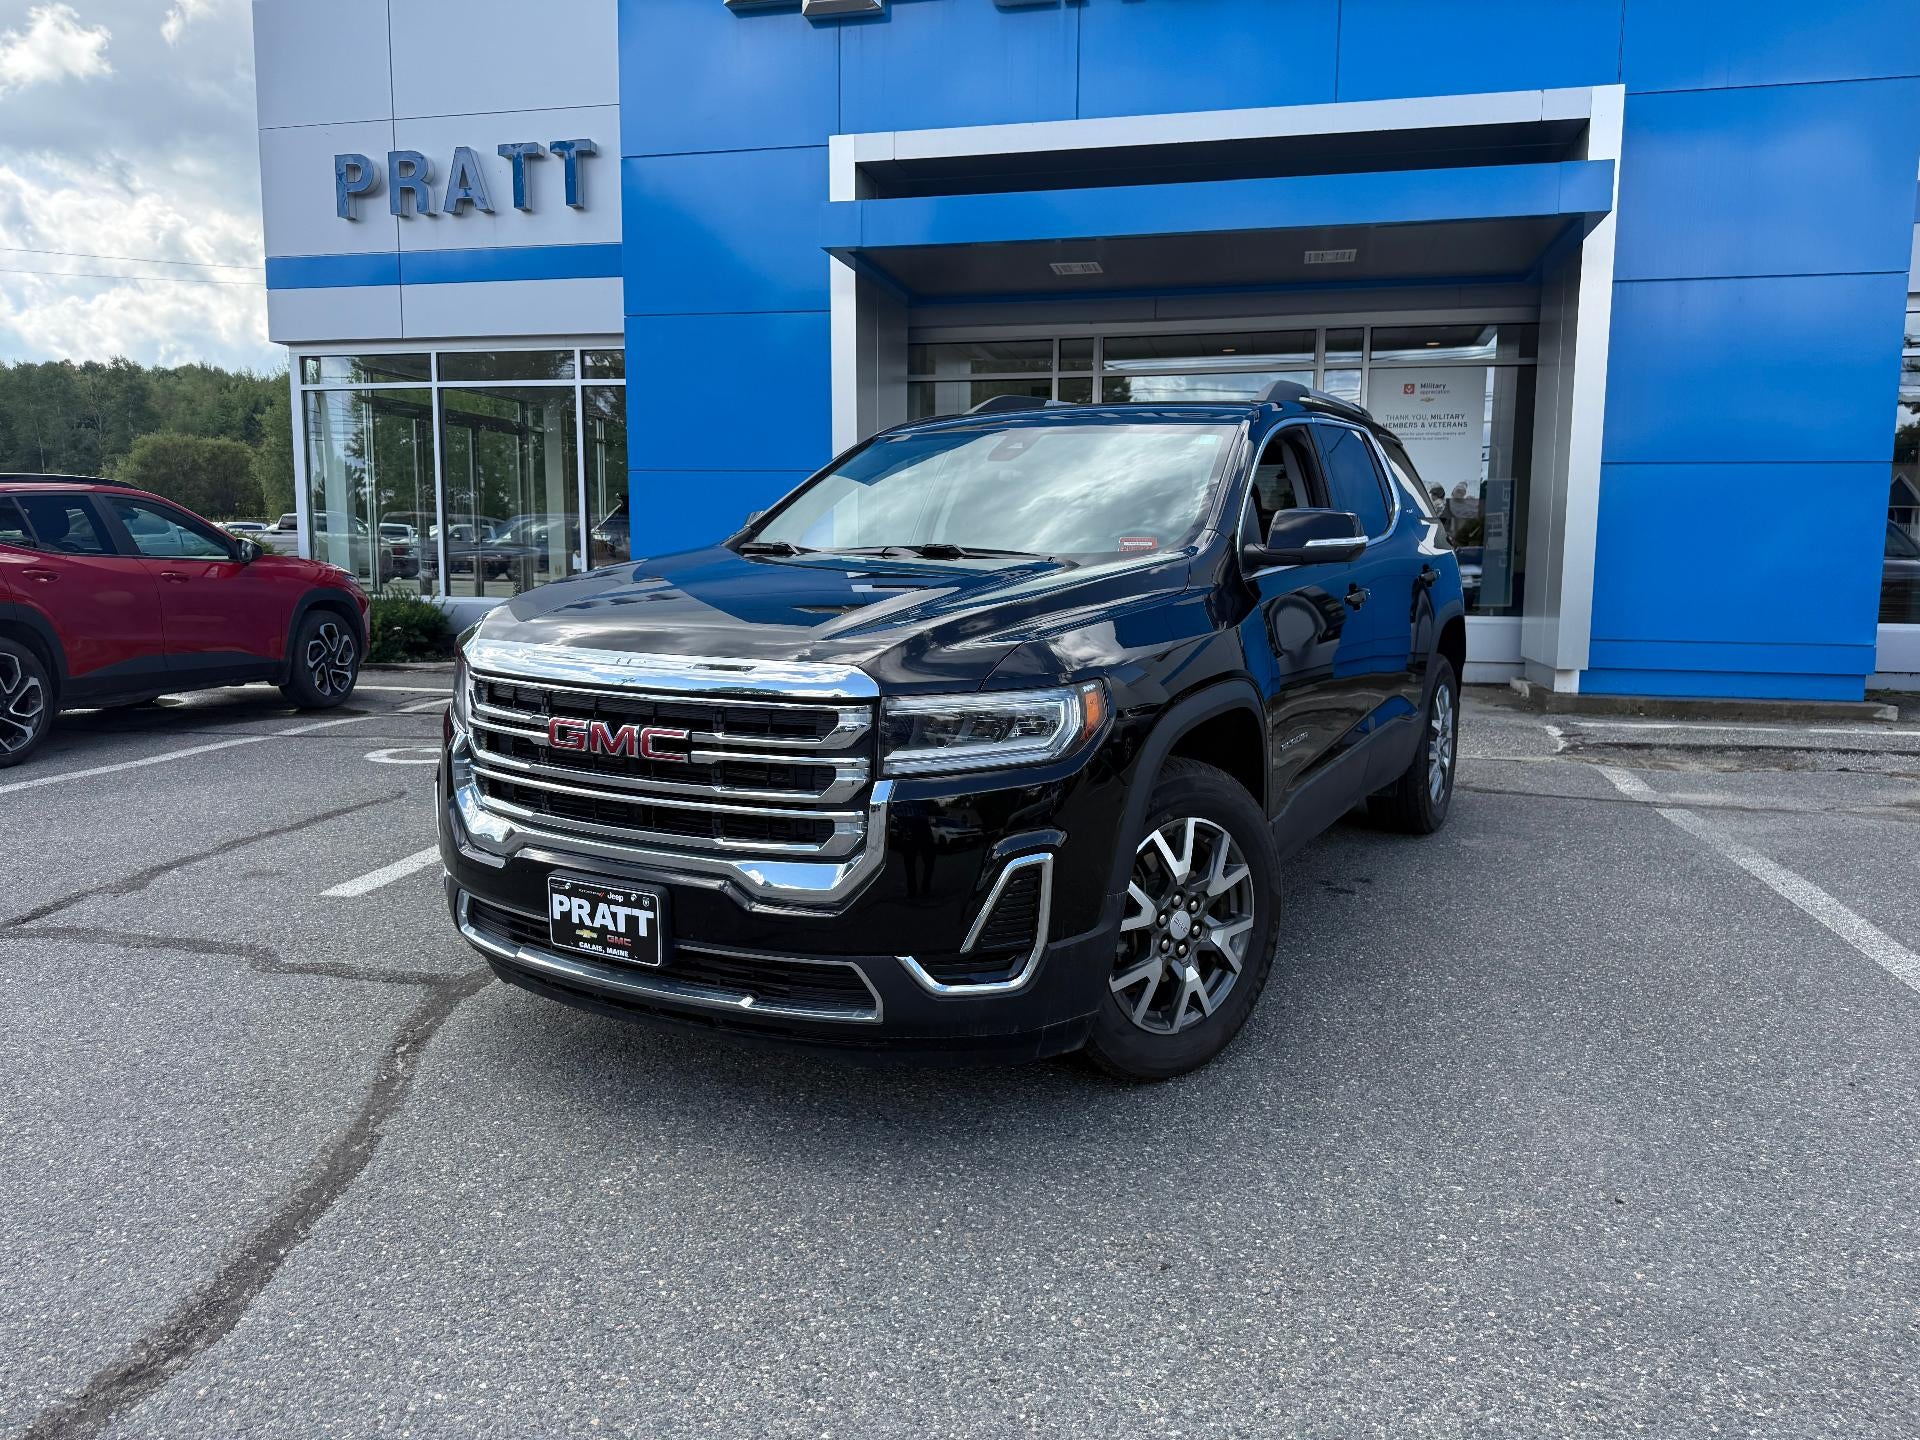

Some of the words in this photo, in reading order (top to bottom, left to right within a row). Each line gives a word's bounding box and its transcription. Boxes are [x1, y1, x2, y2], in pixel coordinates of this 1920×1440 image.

[334, 139, 597, 220] PRATT
[548, 716, 690, 763] GMC
[607, 892, 624, 902] Jeep
[552, 893, 655, 937] PRATT
[579, 941, 605, 953] CALAIS,
[606, 947, 629, 957] MAINE
[606, 934, 632, 947] GMC
